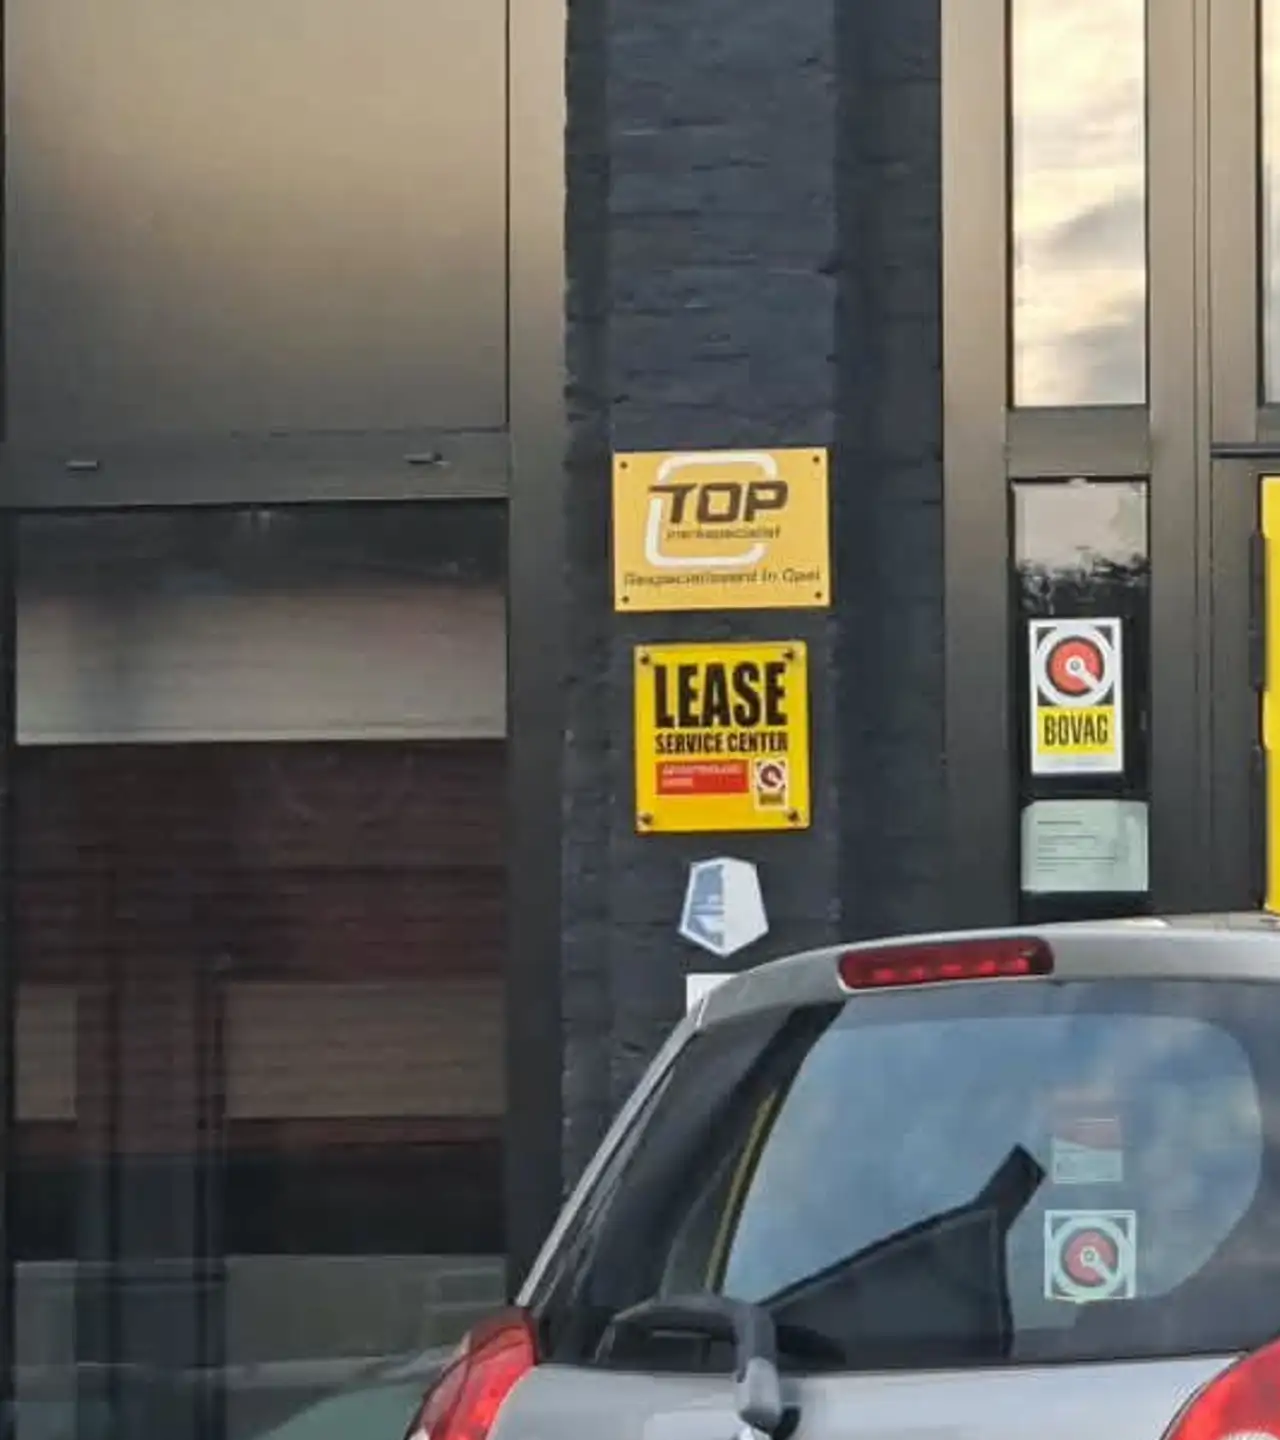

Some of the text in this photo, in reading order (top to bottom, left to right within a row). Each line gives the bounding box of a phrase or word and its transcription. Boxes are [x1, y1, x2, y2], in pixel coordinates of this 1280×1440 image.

[648, 481, 788, 523] TOP
[654, 662, 788, 729] LEASE
[654, 732, 788, 755] SERVICE CENTER
[1043, 714, 1108, 747] BOVAG
